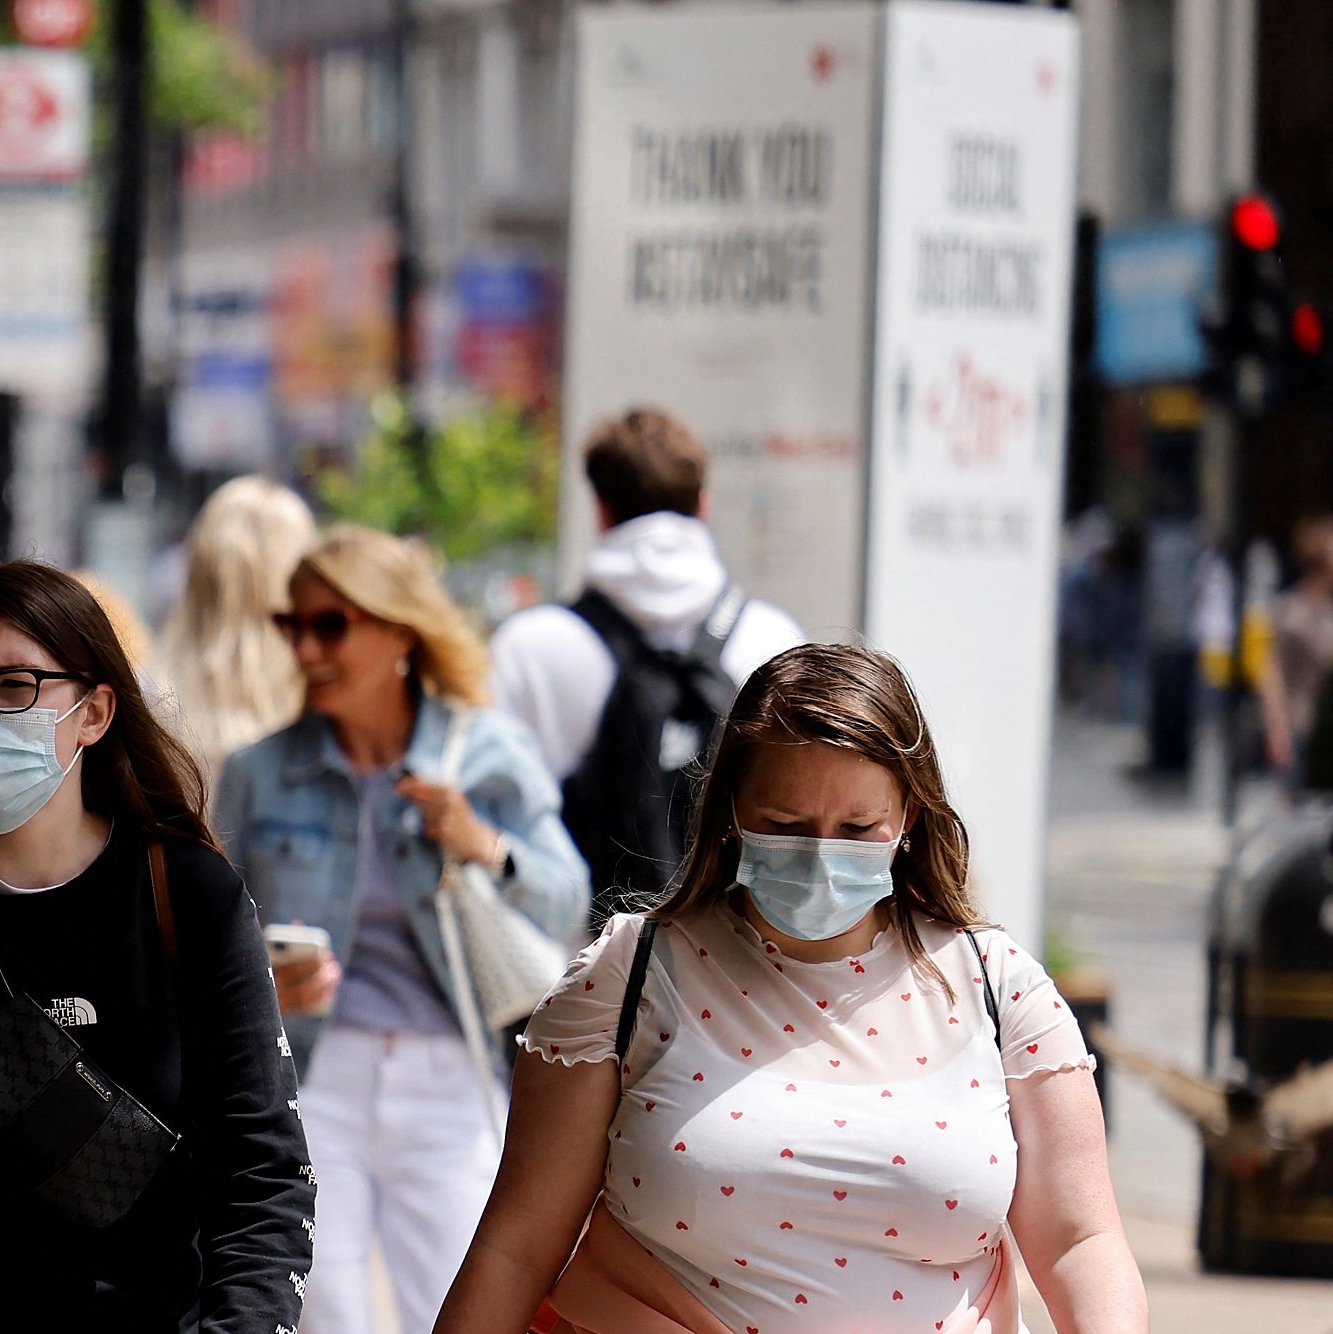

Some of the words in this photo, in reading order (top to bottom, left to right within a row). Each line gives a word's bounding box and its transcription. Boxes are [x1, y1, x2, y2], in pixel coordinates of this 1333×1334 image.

[758, 122, 832, 206] YOU
[51, 998, 74, 1008] THE
[43, 1007, 75, 1018] ORTH
[53, 1016, 75, 1027] ACE
